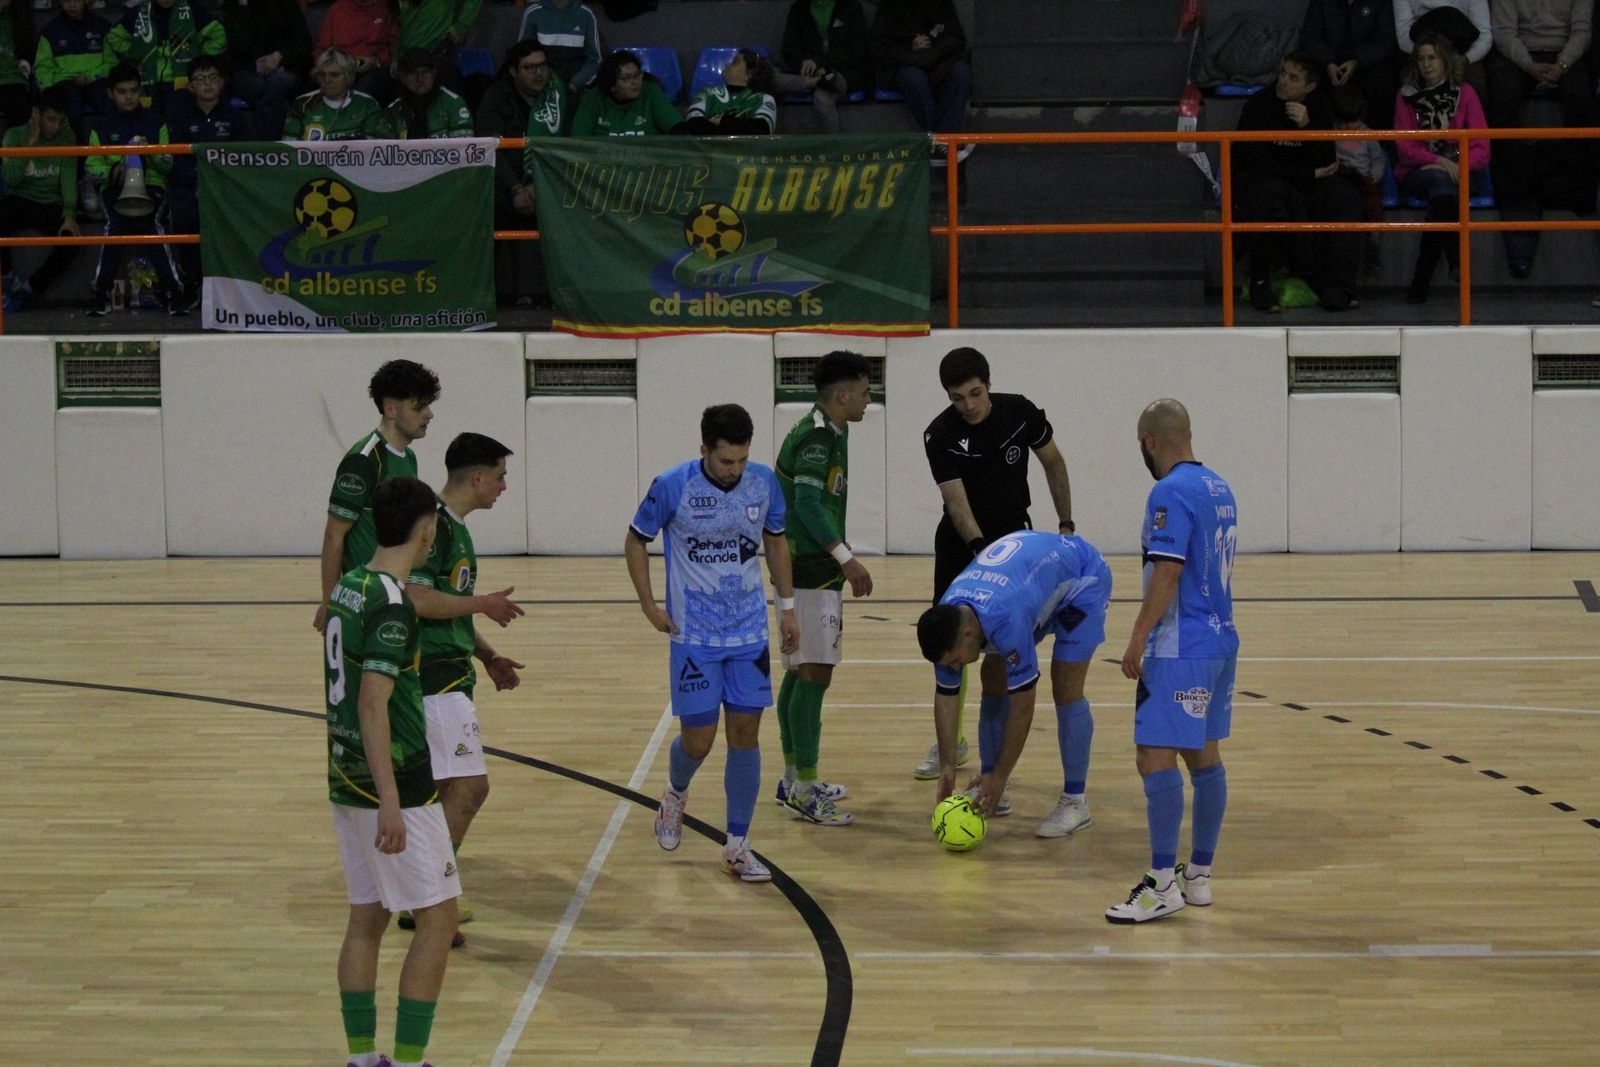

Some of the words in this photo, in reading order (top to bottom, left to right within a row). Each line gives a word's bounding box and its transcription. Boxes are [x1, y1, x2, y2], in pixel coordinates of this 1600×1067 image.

[206, 148, 289, 167] Piensos
[296, 145, 364, 167] Durán
[369, 145, 459, 166] Albense
[465, 143, 486, 163] fs
[736, 153, 828, 165] PIENSOS
[563, 161, 710, 222] VAMOS
[730, 162, 905, 219] ALBENSE
[260, 271, 290, 294] cd
[299, 271, 406, 296] albense
[415, 270, 438, 293] fs
[649, 291, 680, 316] cd
[688, 291, 792, 317] albense
[799, 291, 824, 316] fs
[215, 308, 239, 324] Un
[244, 308, 310, 329] pueblo,
[315, 315, 338, 328] un
[342, 311, 385, 330] club,
[391, 313, 422, 327] una
[427, 308, 486, 326] afición
[687, 537, 737, 550] Dehesa
[687, 549, 738, 563] Grande
[326, 616, 346, 706] 9
[679, 680, 710, 693] ACTIO
